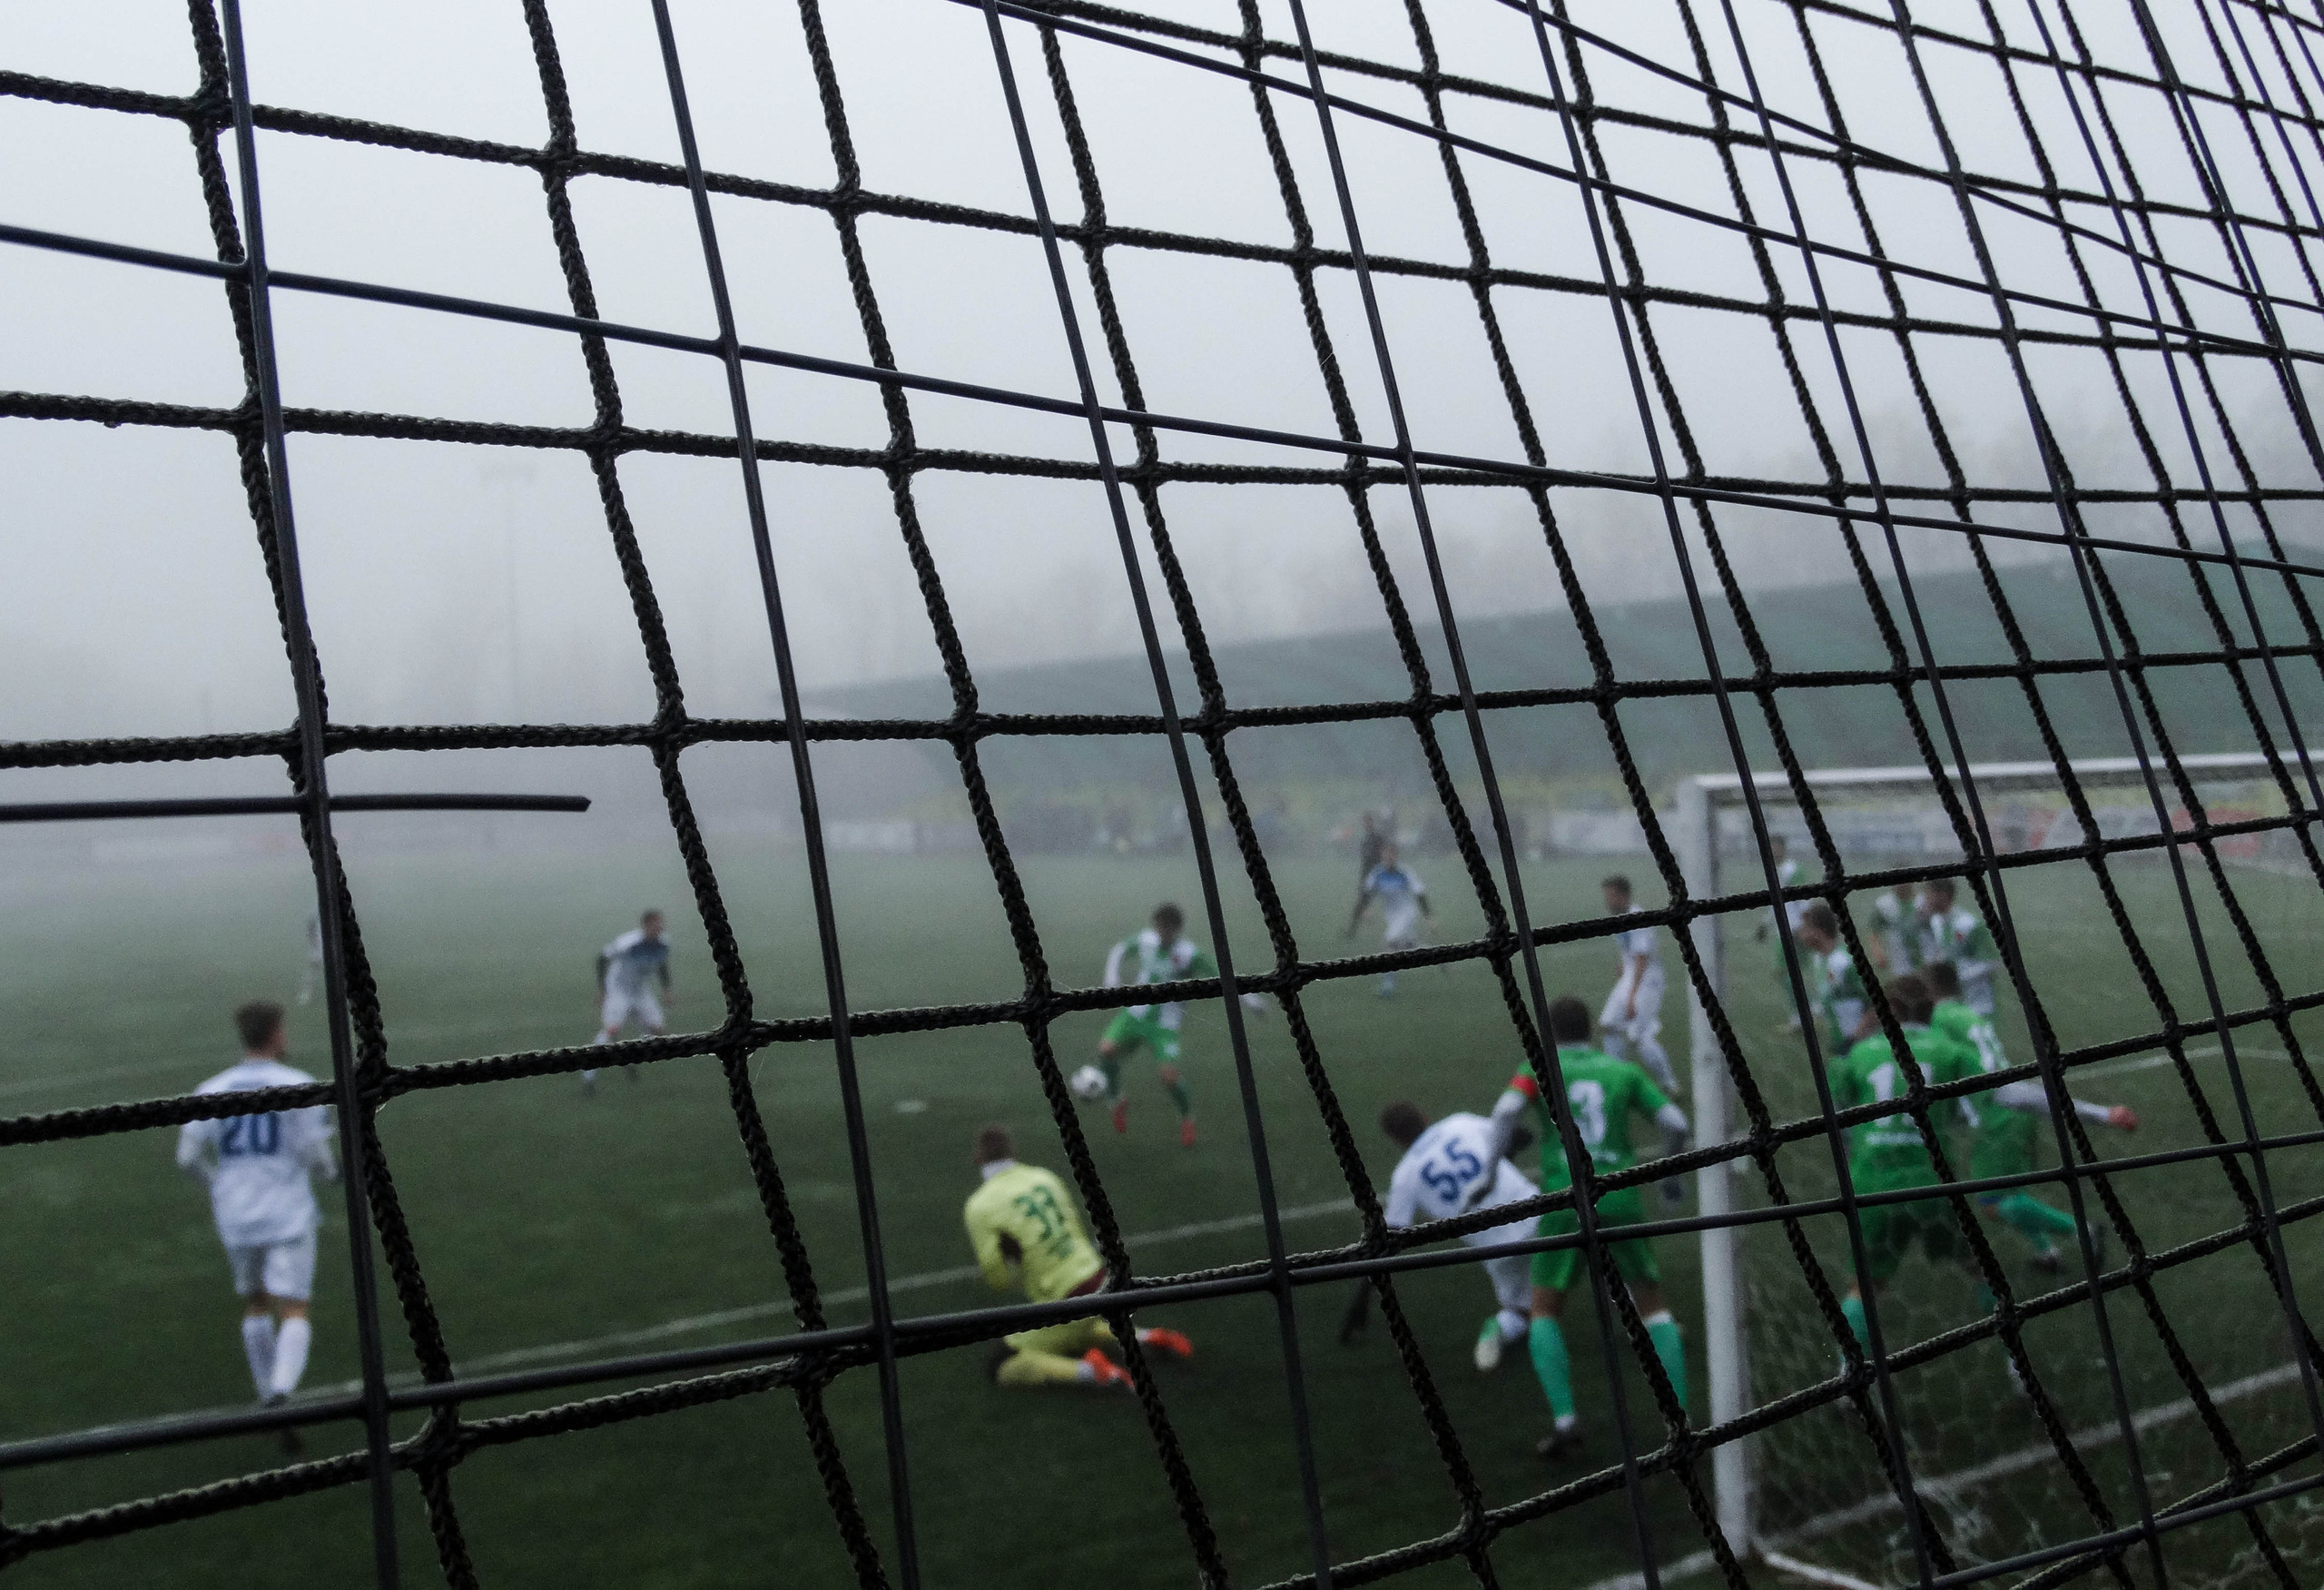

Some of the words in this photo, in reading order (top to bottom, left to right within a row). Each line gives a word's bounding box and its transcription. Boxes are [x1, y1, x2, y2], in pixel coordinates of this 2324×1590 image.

[220, 1110, 281, 1157] 20
[1568, 1078, 1607, 1146] 3
[1420, 1135, 1482, 1203] 55
